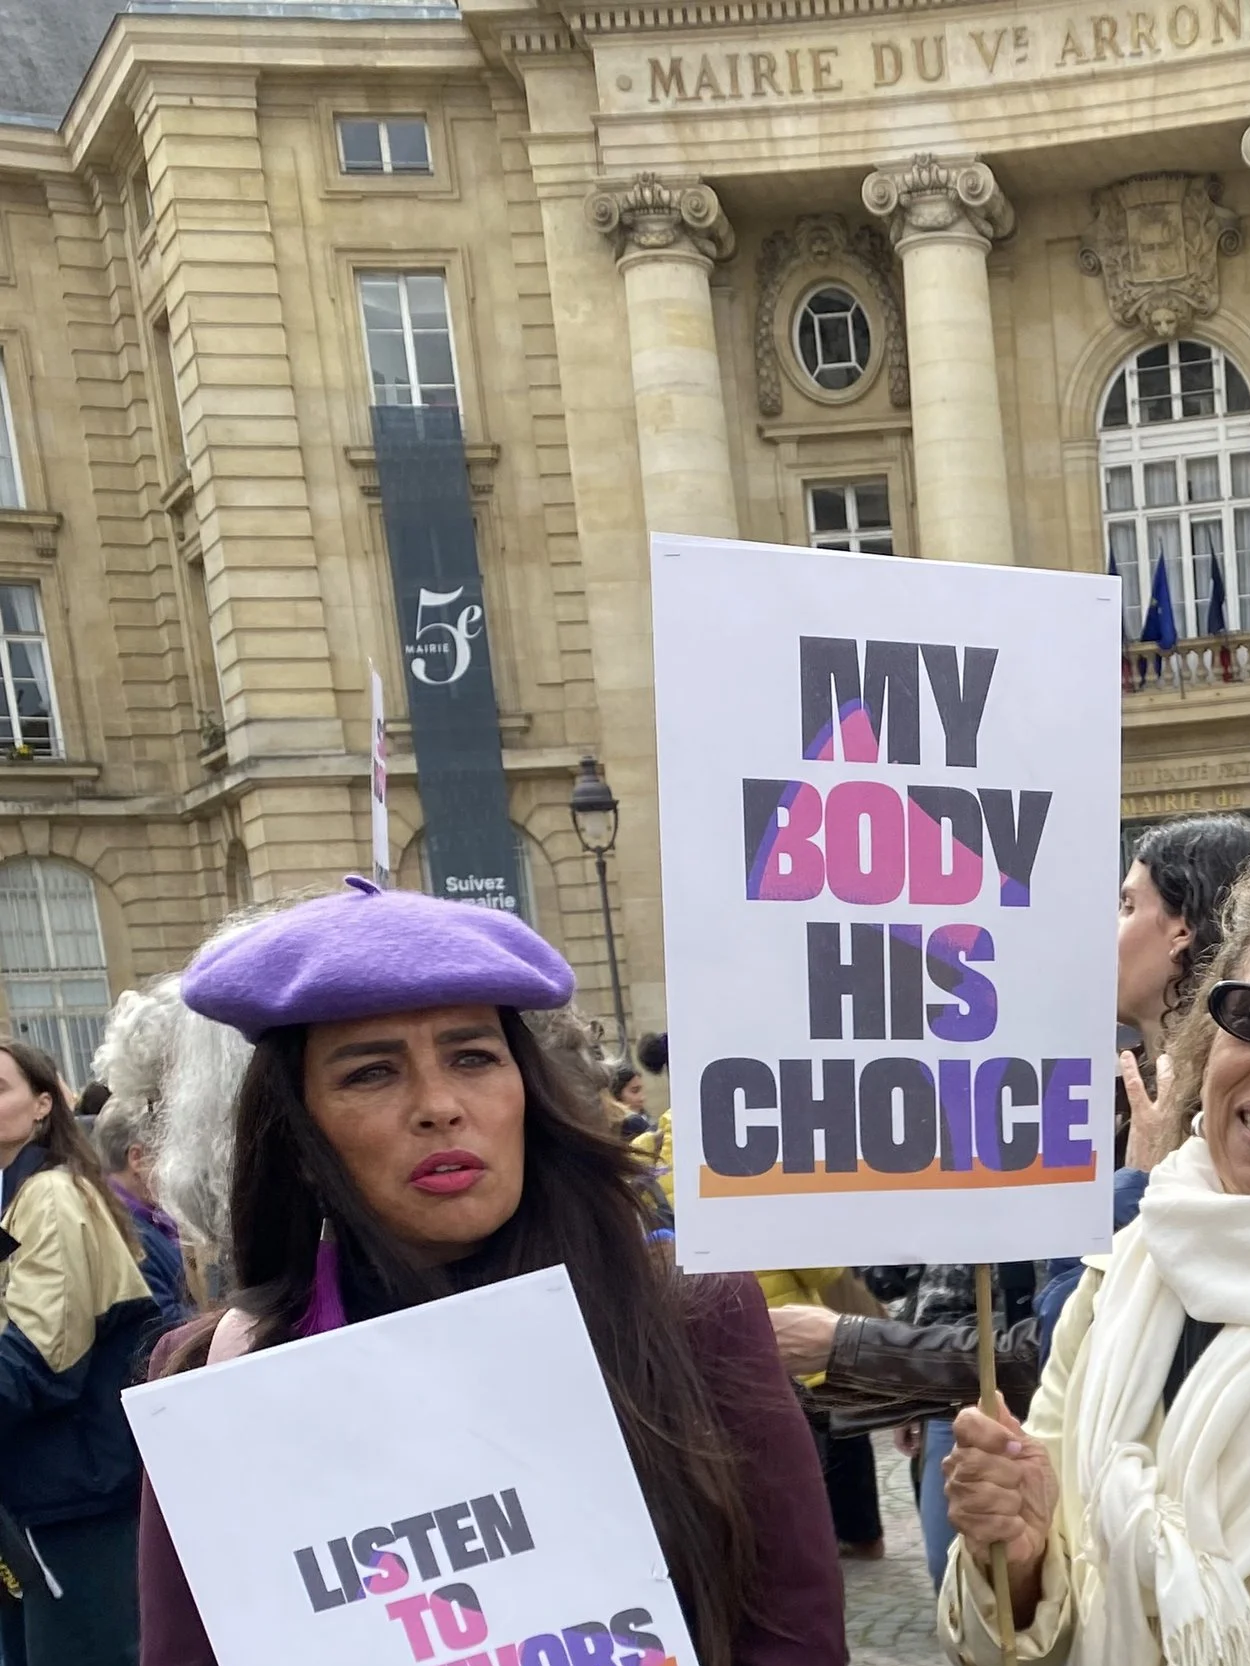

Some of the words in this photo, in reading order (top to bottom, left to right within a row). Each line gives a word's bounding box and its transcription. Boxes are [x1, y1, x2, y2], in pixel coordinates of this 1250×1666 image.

[648, 46, 843, 103] MAIRIE
[871, 35, 947, 88] DU
[405, 643, 449, 655] MAIRIE
[411, 586, 483, 685] 5e
[799, 635, 999, 768] MY
[446, 874, 506, 892] Suivez
[742, 777, 1052, 908] BODY
[806, 921, 998, 1043] HIS
[699, 1056, 1094, 1178] CHOICE
[293, 1487, 535, 1613] LISTEN
[389, 1582, 489, 1663] TO
